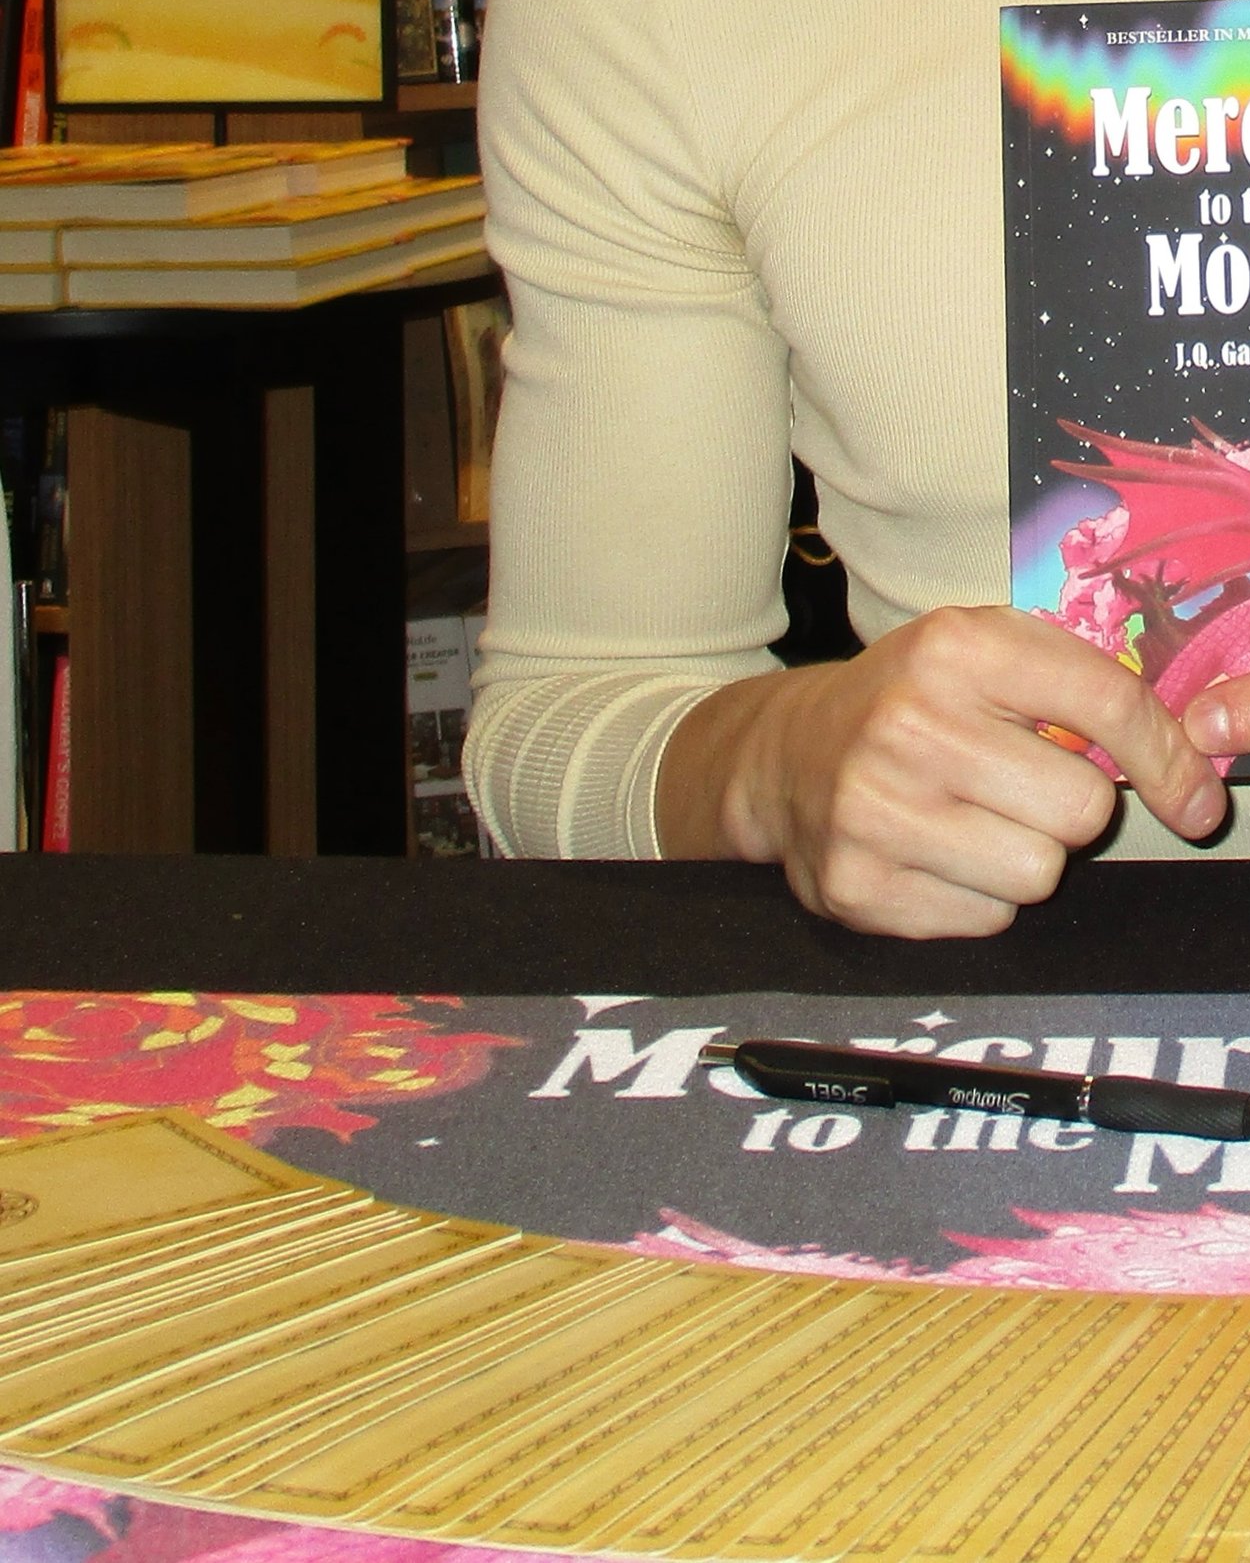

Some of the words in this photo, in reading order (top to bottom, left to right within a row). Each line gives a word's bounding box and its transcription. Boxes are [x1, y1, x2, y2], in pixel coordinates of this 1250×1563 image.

[1106, 27, 1210, 45] BESTSELLER
[1213, 29, 1234, 42] IN
[1199, 189, 1232, 225] to
[1174, 342, 1215, 369] J.Q.
[948, 1086, 1031, 1115] Sharpie
[741, 1107, 863, 1153] to
[903, 1107, 1096, 1152] the
